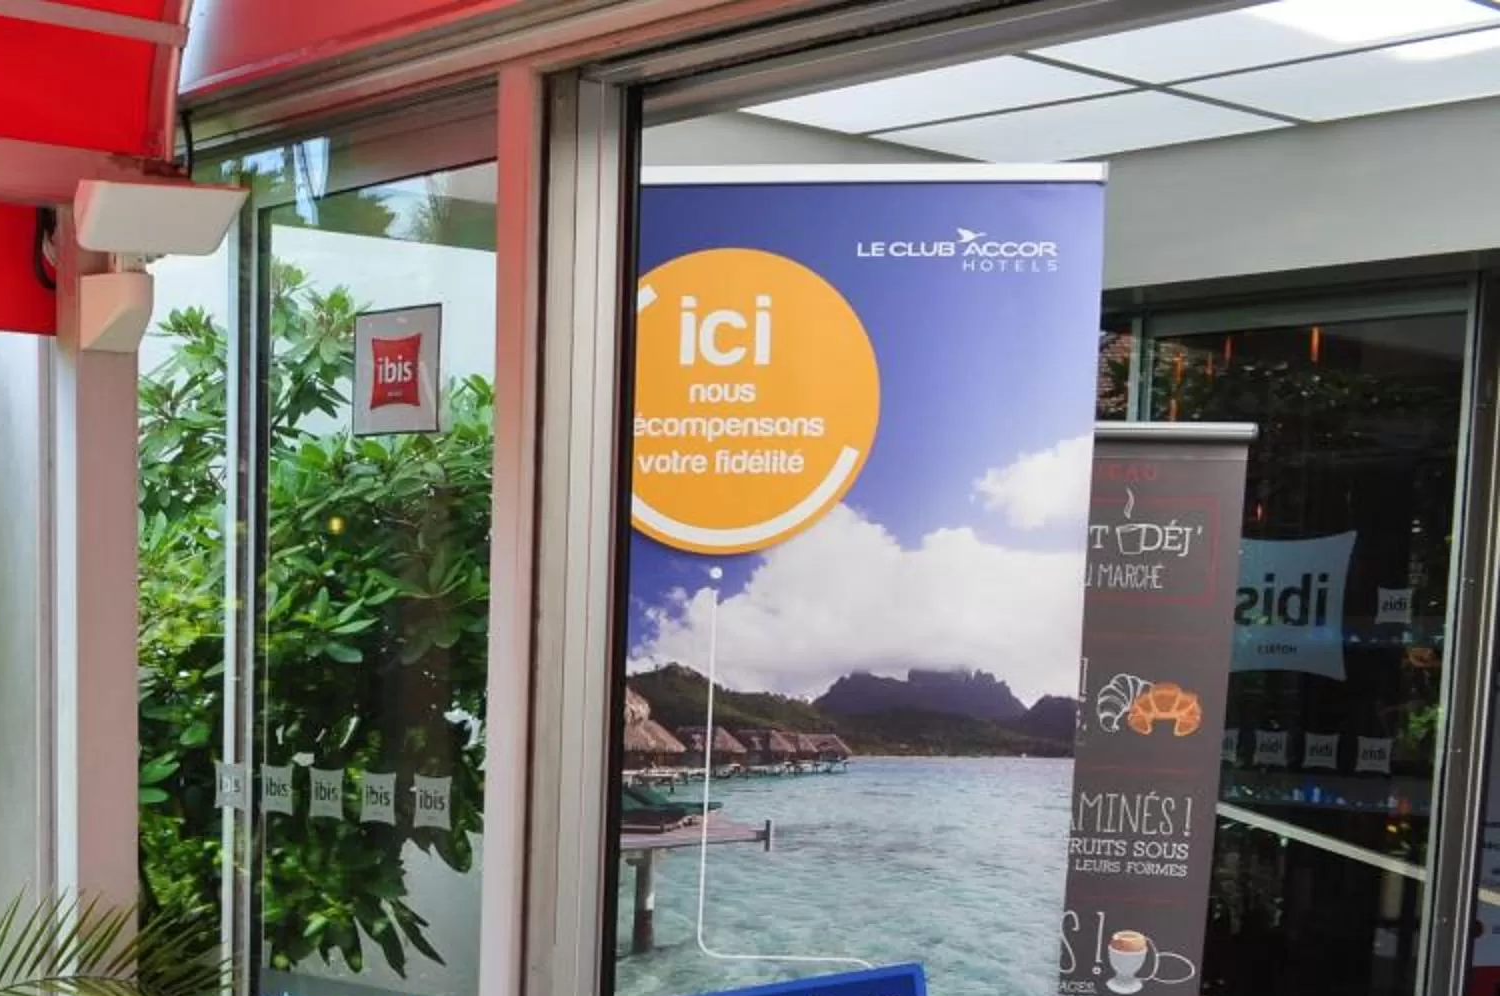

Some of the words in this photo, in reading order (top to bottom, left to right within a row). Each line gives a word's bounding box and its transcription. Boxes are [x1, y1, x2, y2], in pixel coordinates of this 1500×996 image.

[857, 242, 885, 258] LE
[889, 241, 955, 258] CLUB
[961, 241, 1059, 258] ACCOR
[962, 259, 1060, 273] HOTELS
[678, 294, 773, 367] ici
[377, 354, 413, 384] ibis
[688, 382, 757, 404] nous
[638, 450, 708, 474] votre
[714, 448, 805, 474] fidélité
[266, 774, 289, 798] ibis
[314, 780, 339, 801] ibis
[366, 785, 391, 808] ibis
[419, 787, 445, 811] ibis
[1068, 836, 1128, 858] RUITS
[1133, 840, 1190, 861] SOUS
[1075, 858, 1121, 875] LEURS
[1125, 861, 1190, 878] FORMES
